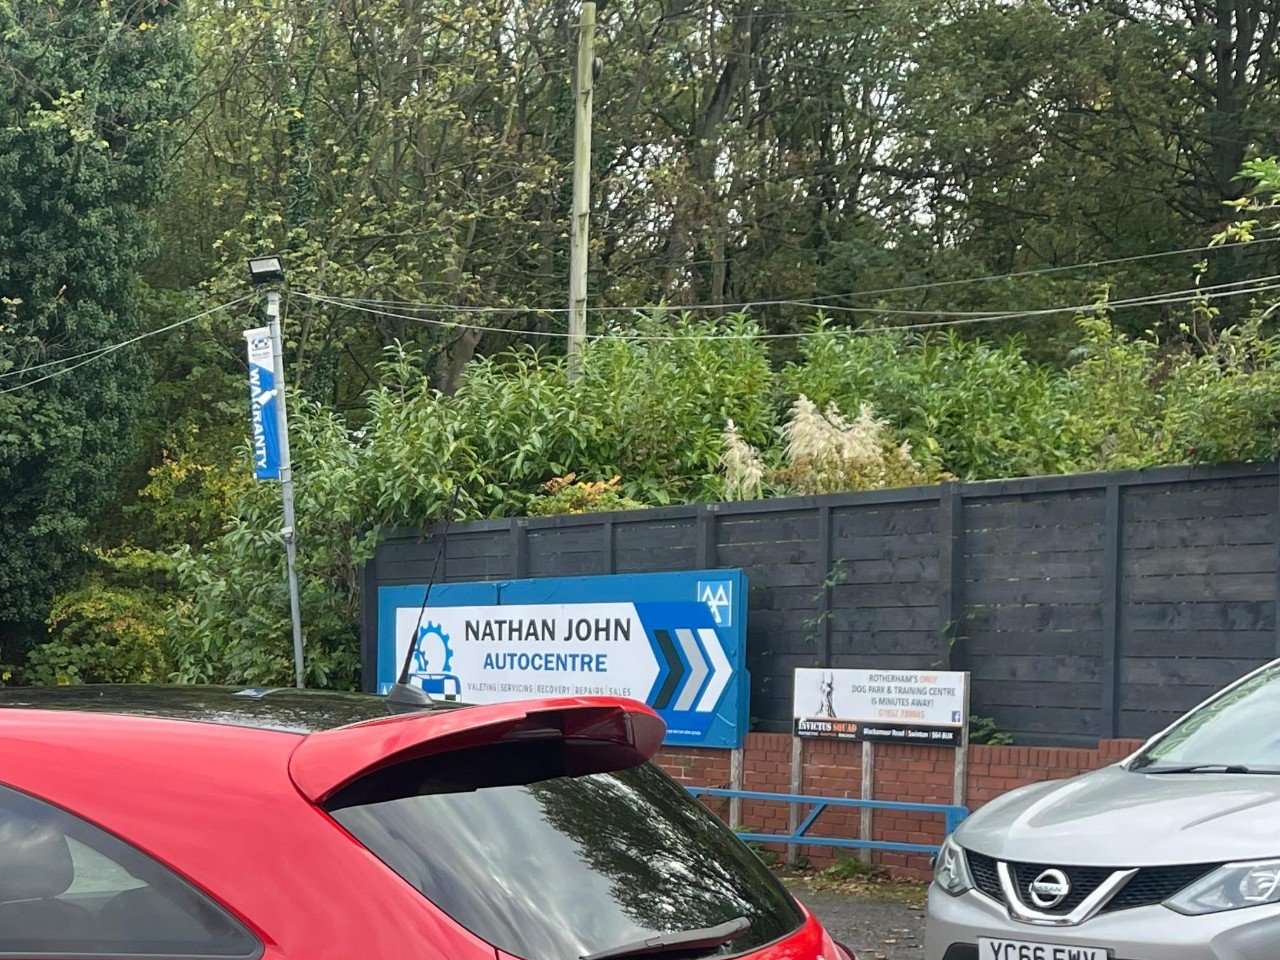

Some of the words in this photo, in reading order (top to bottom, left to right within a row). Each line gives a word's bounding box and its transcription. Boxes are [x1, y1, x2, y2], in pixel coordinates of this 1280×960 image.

[464, 619, 556, 641] NATHAN
[563, 618, 631, 641] JOHN
[483, 653, 608, 672] AUTOCENTRE
[869, 674, 918, 683] ROTHERHAM'S
[467, 683, 497, 692] VALETING
[500, 683, 533, 693] SERVICING
[537, 684, 570, 695] RECOVERY
[575, 685, 604, 696] REPAIRS
[608, 687, 631, 697] SALES
[851, 685, 866, 693] DOG
[868, 686, 885, 694] PARK
[887, 686, 892, 694] &
[894, 687, 927, 696] TRAINING
[929, 688, 956, 696] CENTRE
[879, 697, 910, 706] MINUTES
[911, 699, 934, 707] AWAY!
